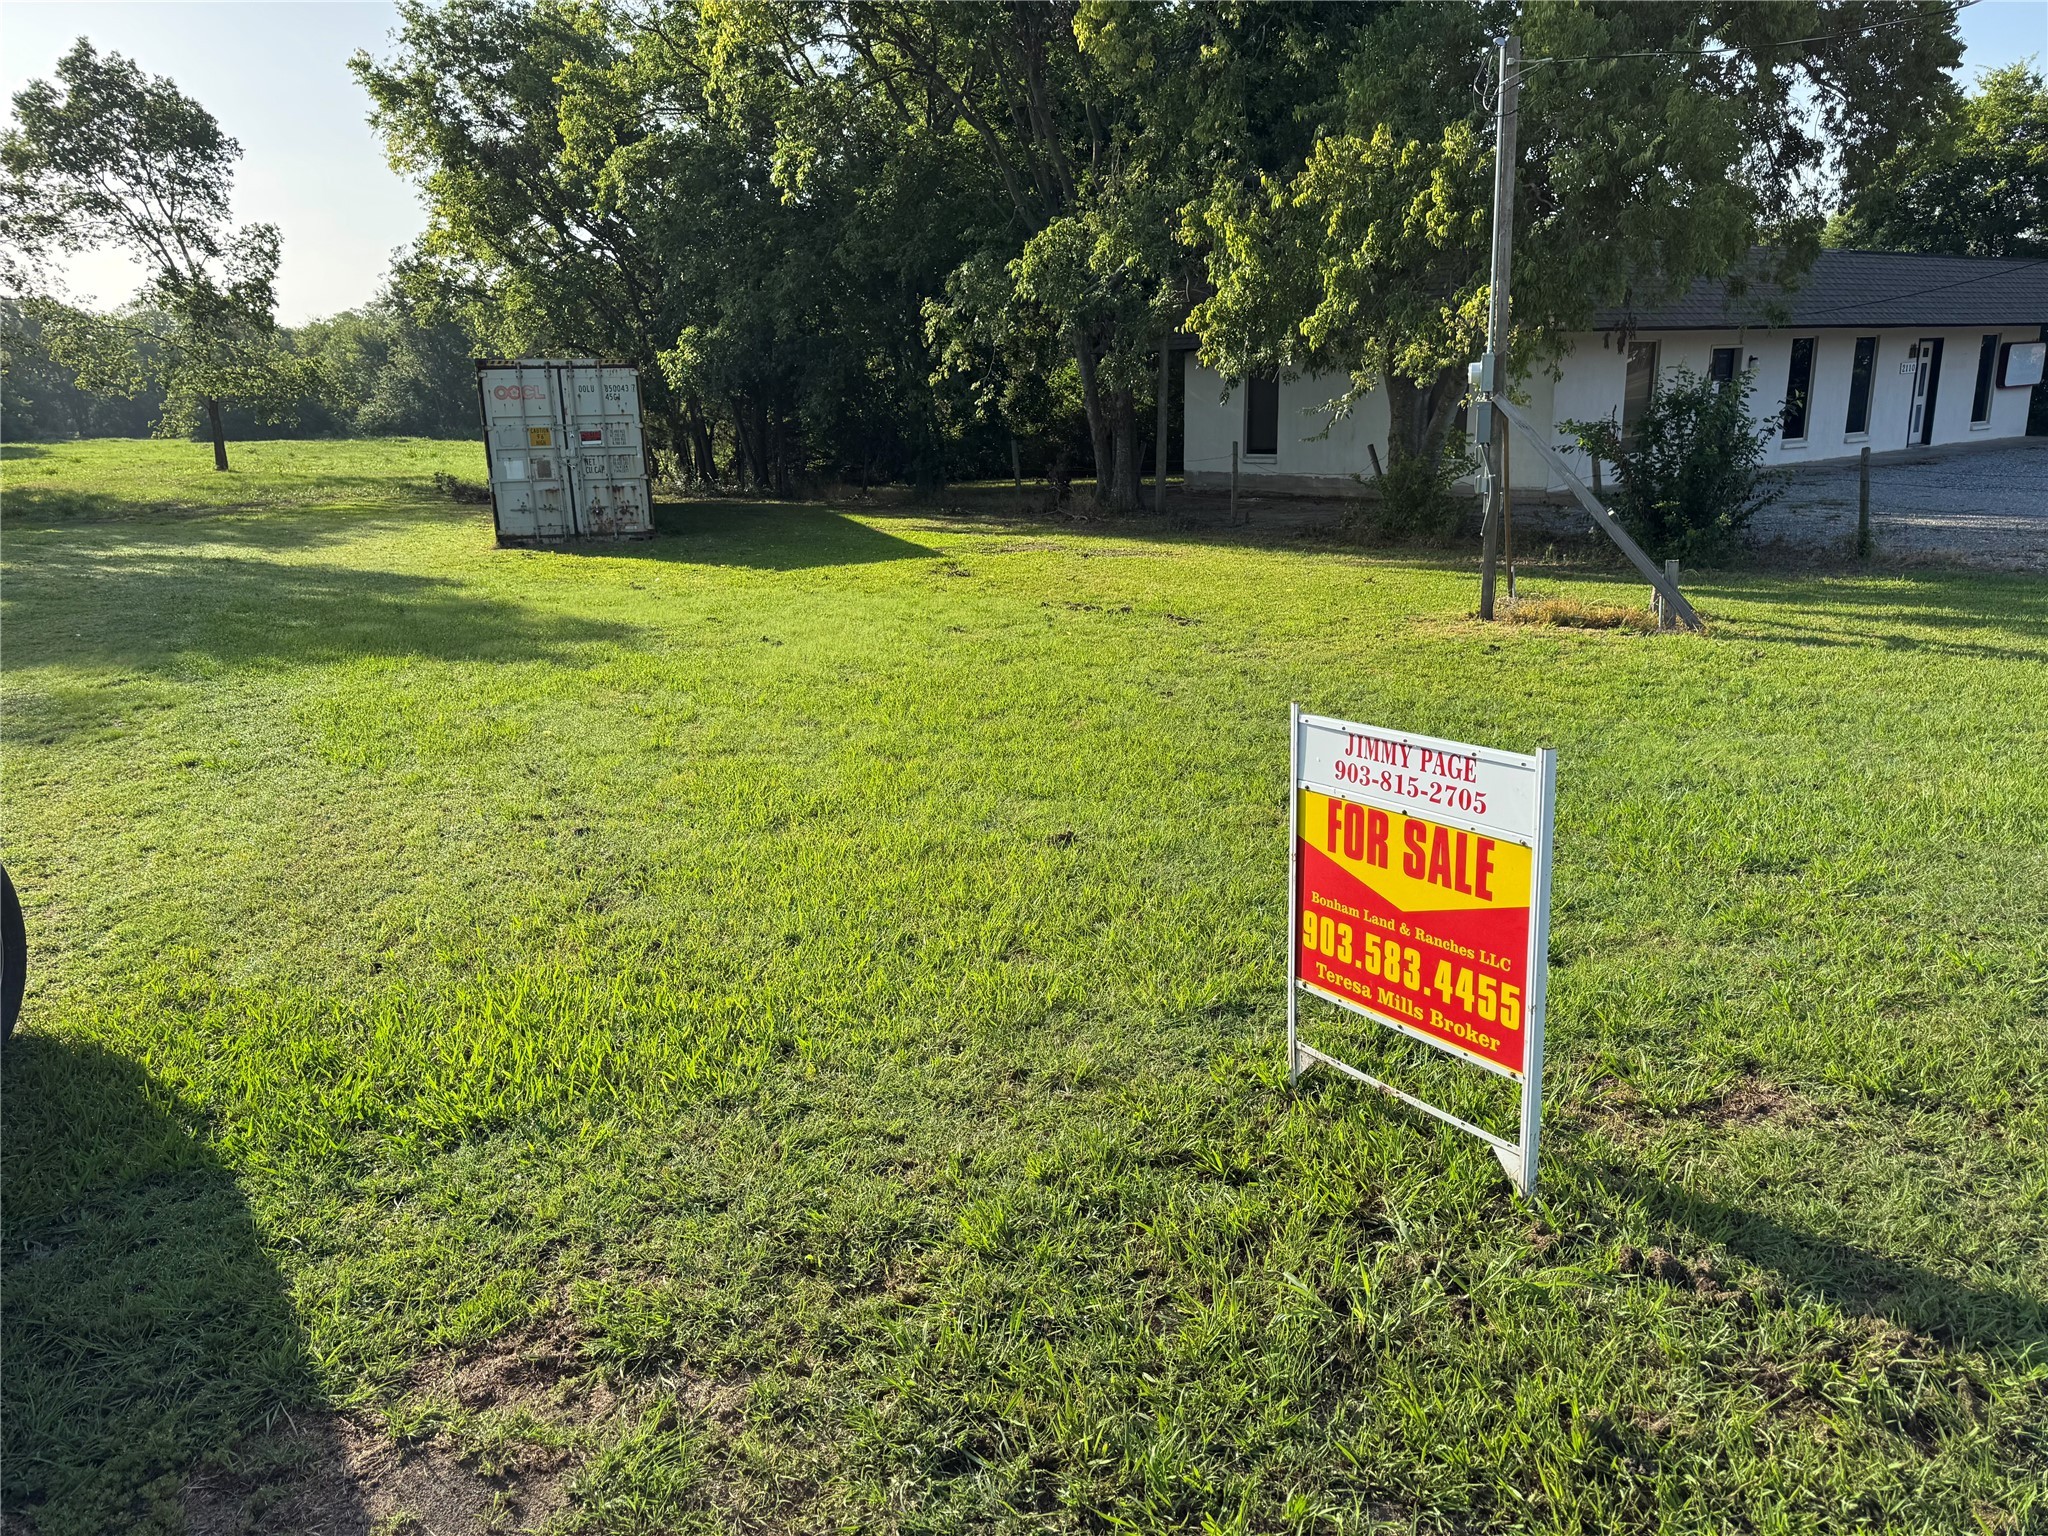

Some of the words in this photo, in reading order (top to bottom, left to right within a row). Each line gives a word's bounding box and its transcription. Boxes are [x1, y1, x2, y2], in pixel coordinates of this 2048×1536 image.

[494, 385, 546, 400] OOCL
[578, 384, 595, 393] OOLU
[604, 384, 629, 393] 850043
[1902, 363, 1916, 372] 2110
[1345, 733, 1413, 769] JIMMY
[1419, 748, 1477, 783] PAGE
[1335, 760, 1487, 814] 903-815-2705
[1327, 797, 1389, 869] FOR
[1403, 818, 1495, 902] SALE
[1311, 891, 1360, 918] Bonham
[1363, 908, 1395, 931] Land
[1399, 922, 1411, 937] &
[1415, 927, 1475, 959] Ranches
[1479, 950, 1511, 972] LLC
[1303, 910, 1520, 1031] 903.583.4455
[1316, 961, 1372, 999] Teresa
[1377, 987, 1424, 1021] Mills
[1430, 1008, 1500, 1052] Broker
